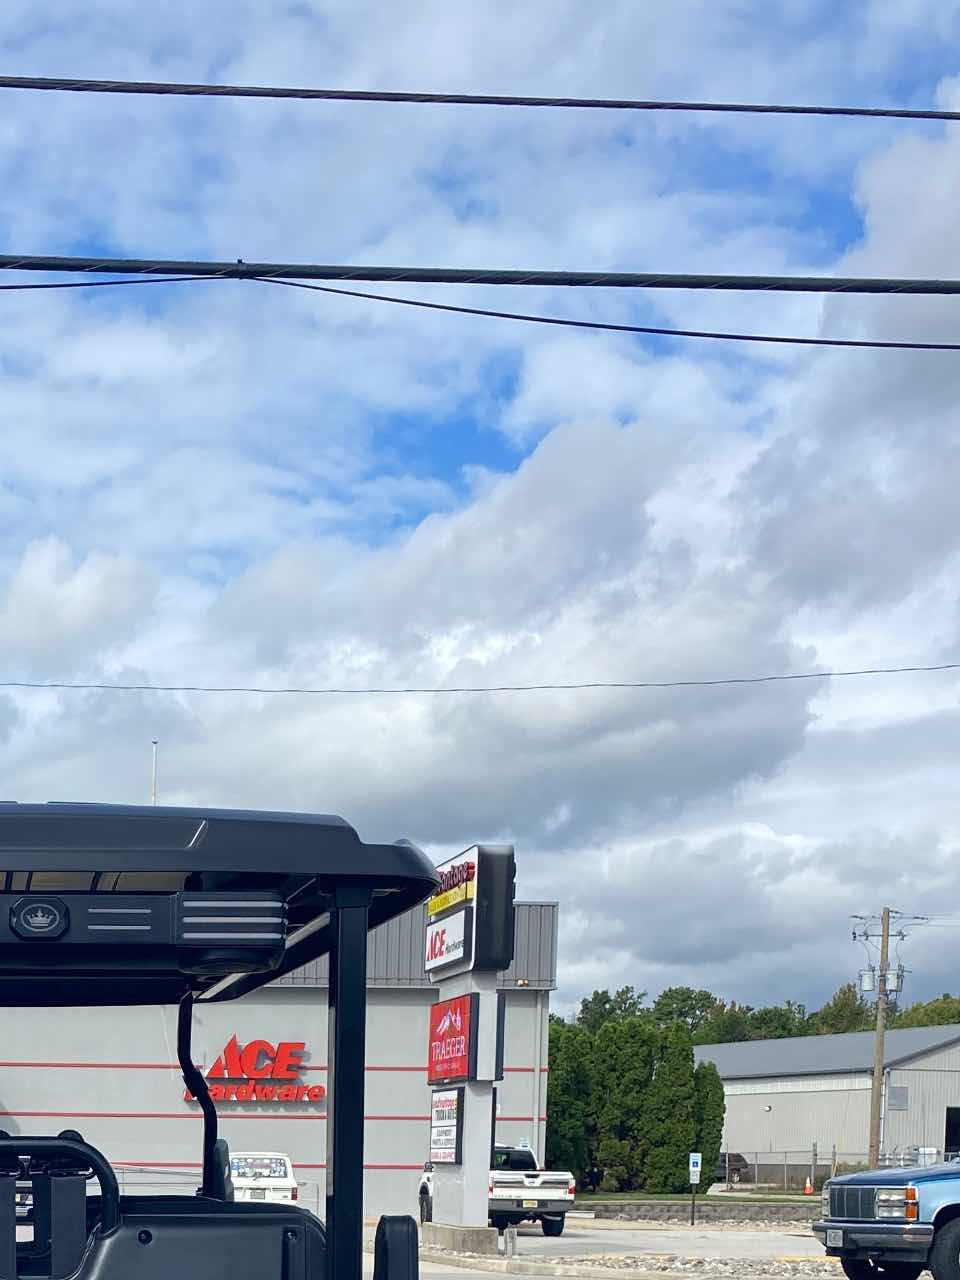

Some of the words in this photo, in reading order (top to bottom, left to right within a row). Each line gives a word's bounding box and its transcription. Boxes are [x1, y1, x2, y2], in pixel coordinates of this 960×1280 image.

[427, 928, 446, 961] ACE
[206, 1032, 305, 1079] ACE
[431, 1036, 466, 1062] TRAEGER
